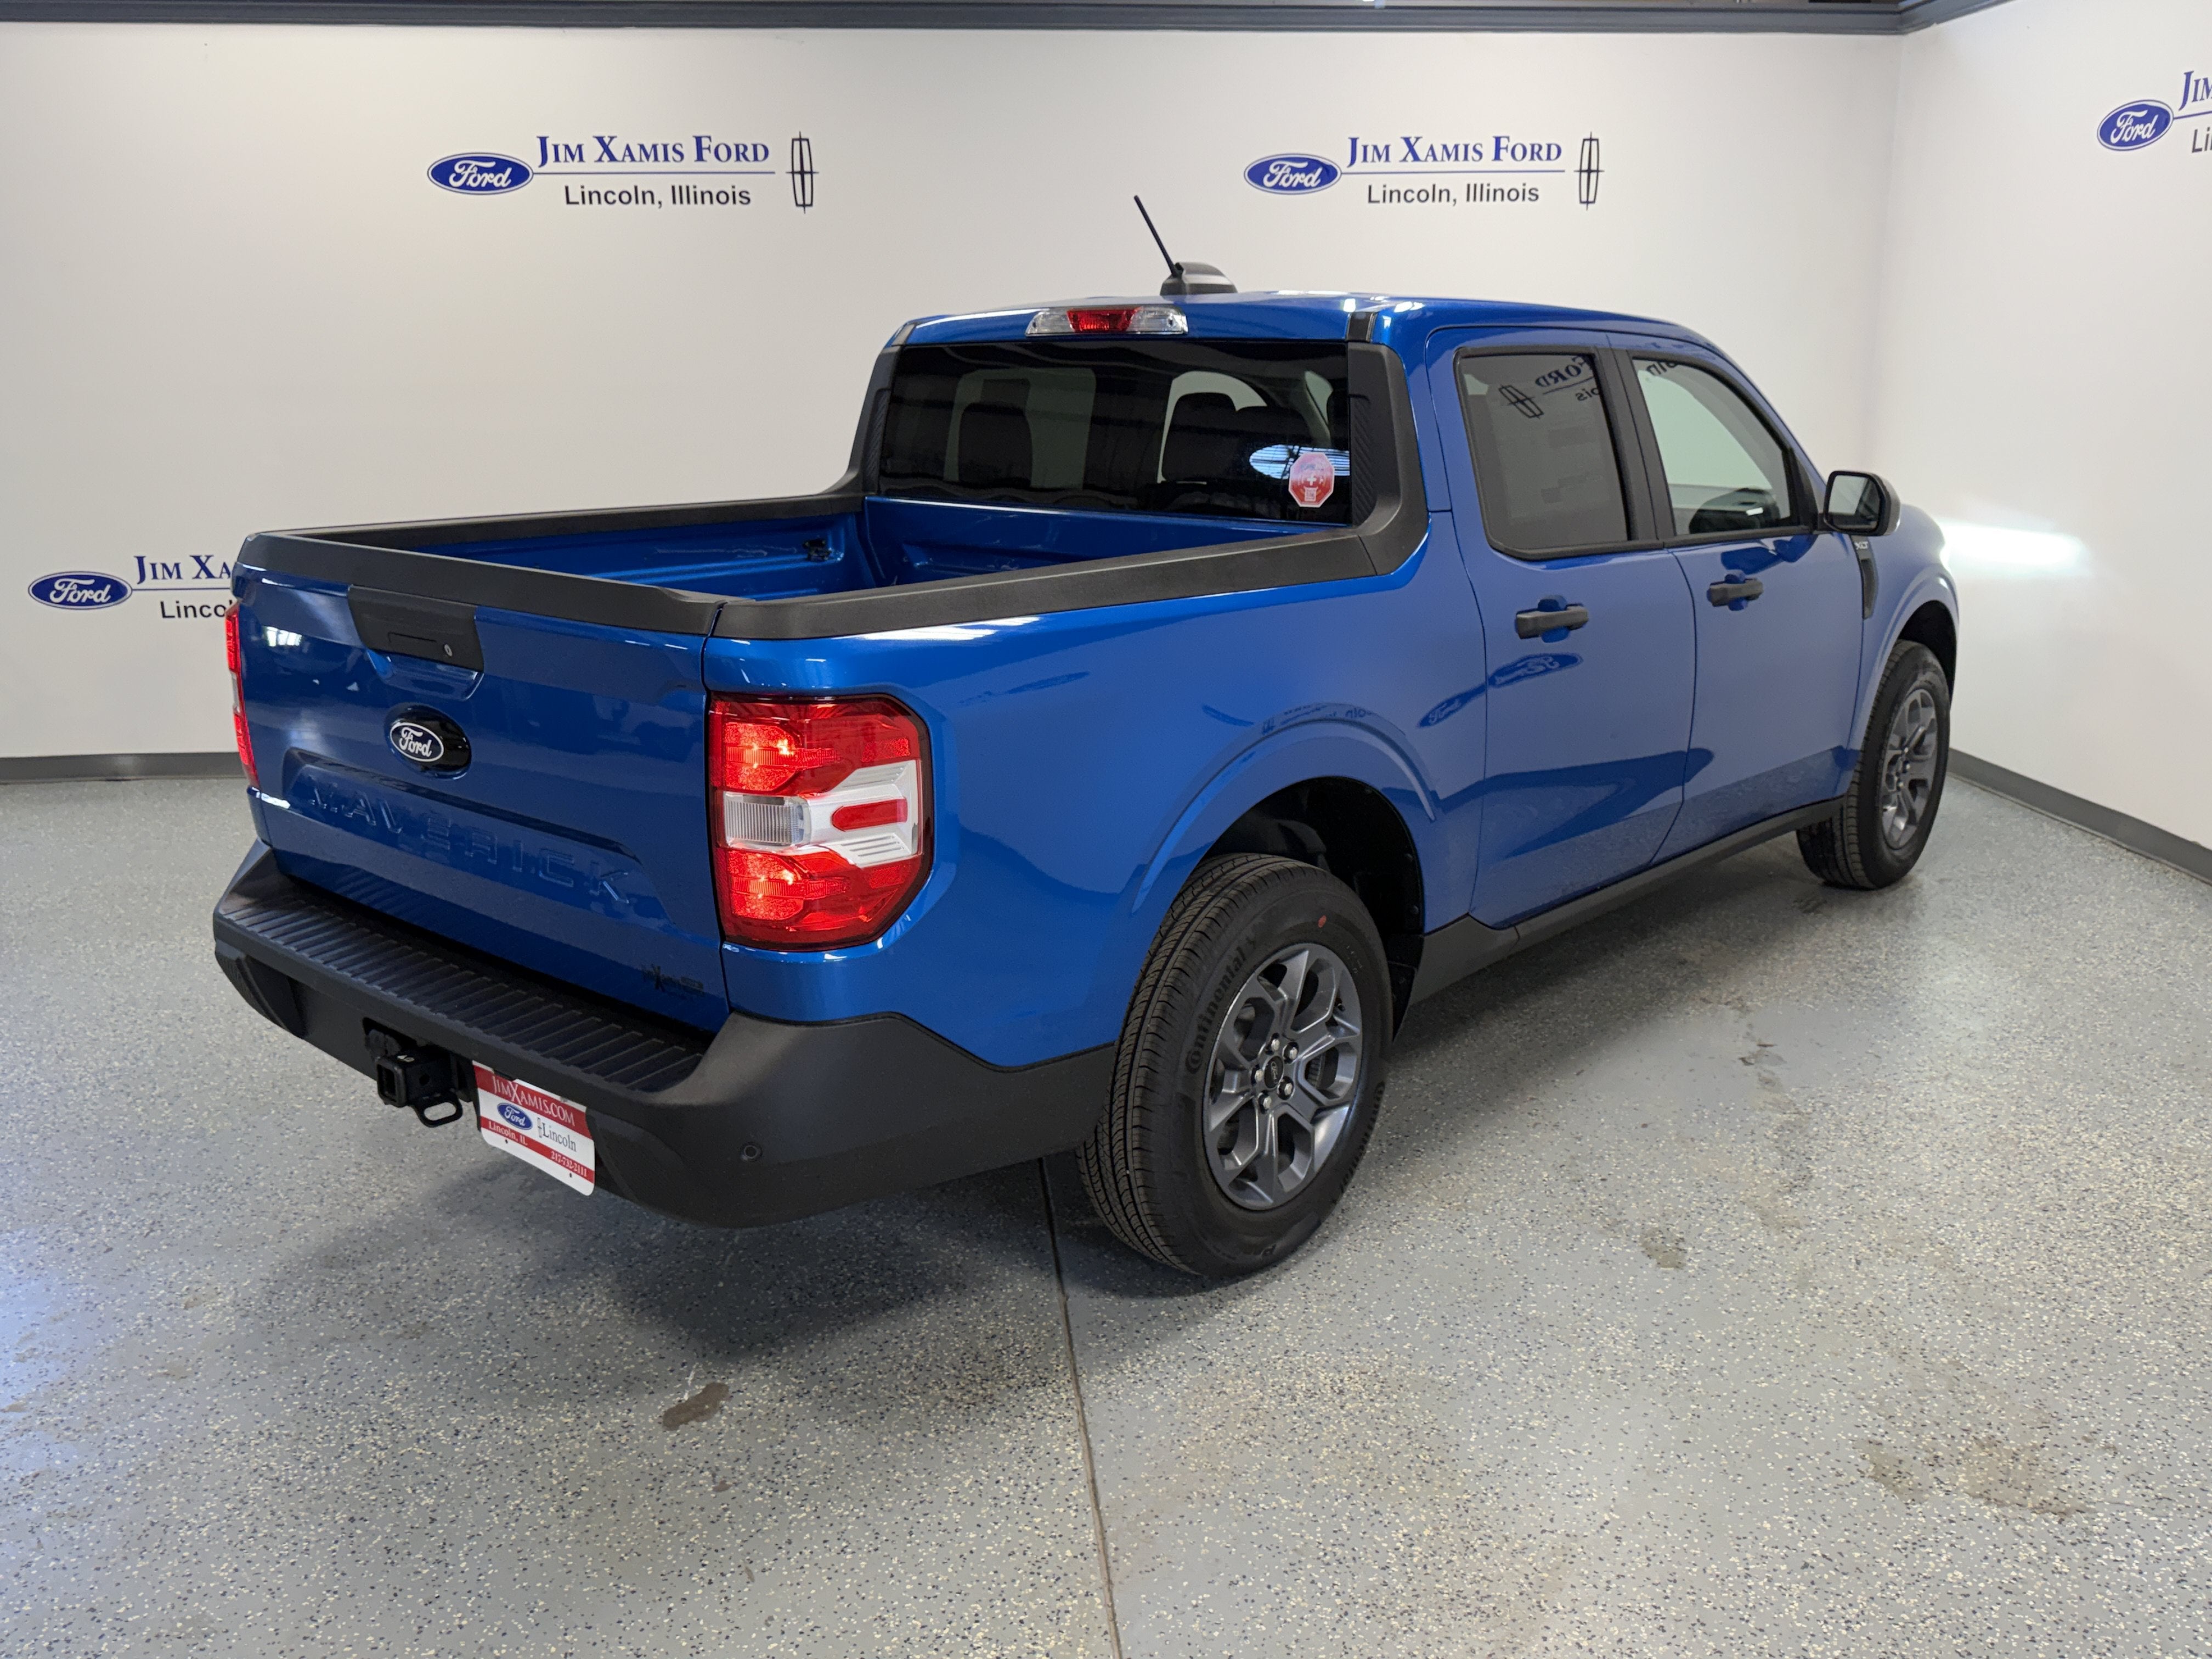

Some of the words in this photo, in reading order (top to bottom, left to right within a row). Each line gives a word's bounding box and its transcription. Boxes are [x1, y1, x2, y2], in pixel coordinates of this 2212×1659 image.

[2110, 109, 2159, 144] Ford
[537, 136, 585, 167] JIM
[593, 136, 684, 163] XAMIS
[692, 136, 769, 162] FORD
[1347, 137, 1390, 167] JIM
[1399, 137, 1483, 162] XAMIS
[1492, 136, 1562, 162] FORD
[448, 160, 512, 189] Ford
[1262, 161, 1321, 189] Ford
[565, 185, 662, 208] Lincoln,
[671, 185, 751, 205] Illinois
[1368, 184, 1457, 206] Lincoln,
[1466, 183, 1539, 202] Illinois
[134, 556, 183, 584] JIM
[49, 578, 111, 604] Ford
[160, 600, 233, 619] Linco
[399, 726, 432, 757] Ford
[504, 1106, 527, 1127] Ford
[542, 1122, 577, 1152] Lincoln
